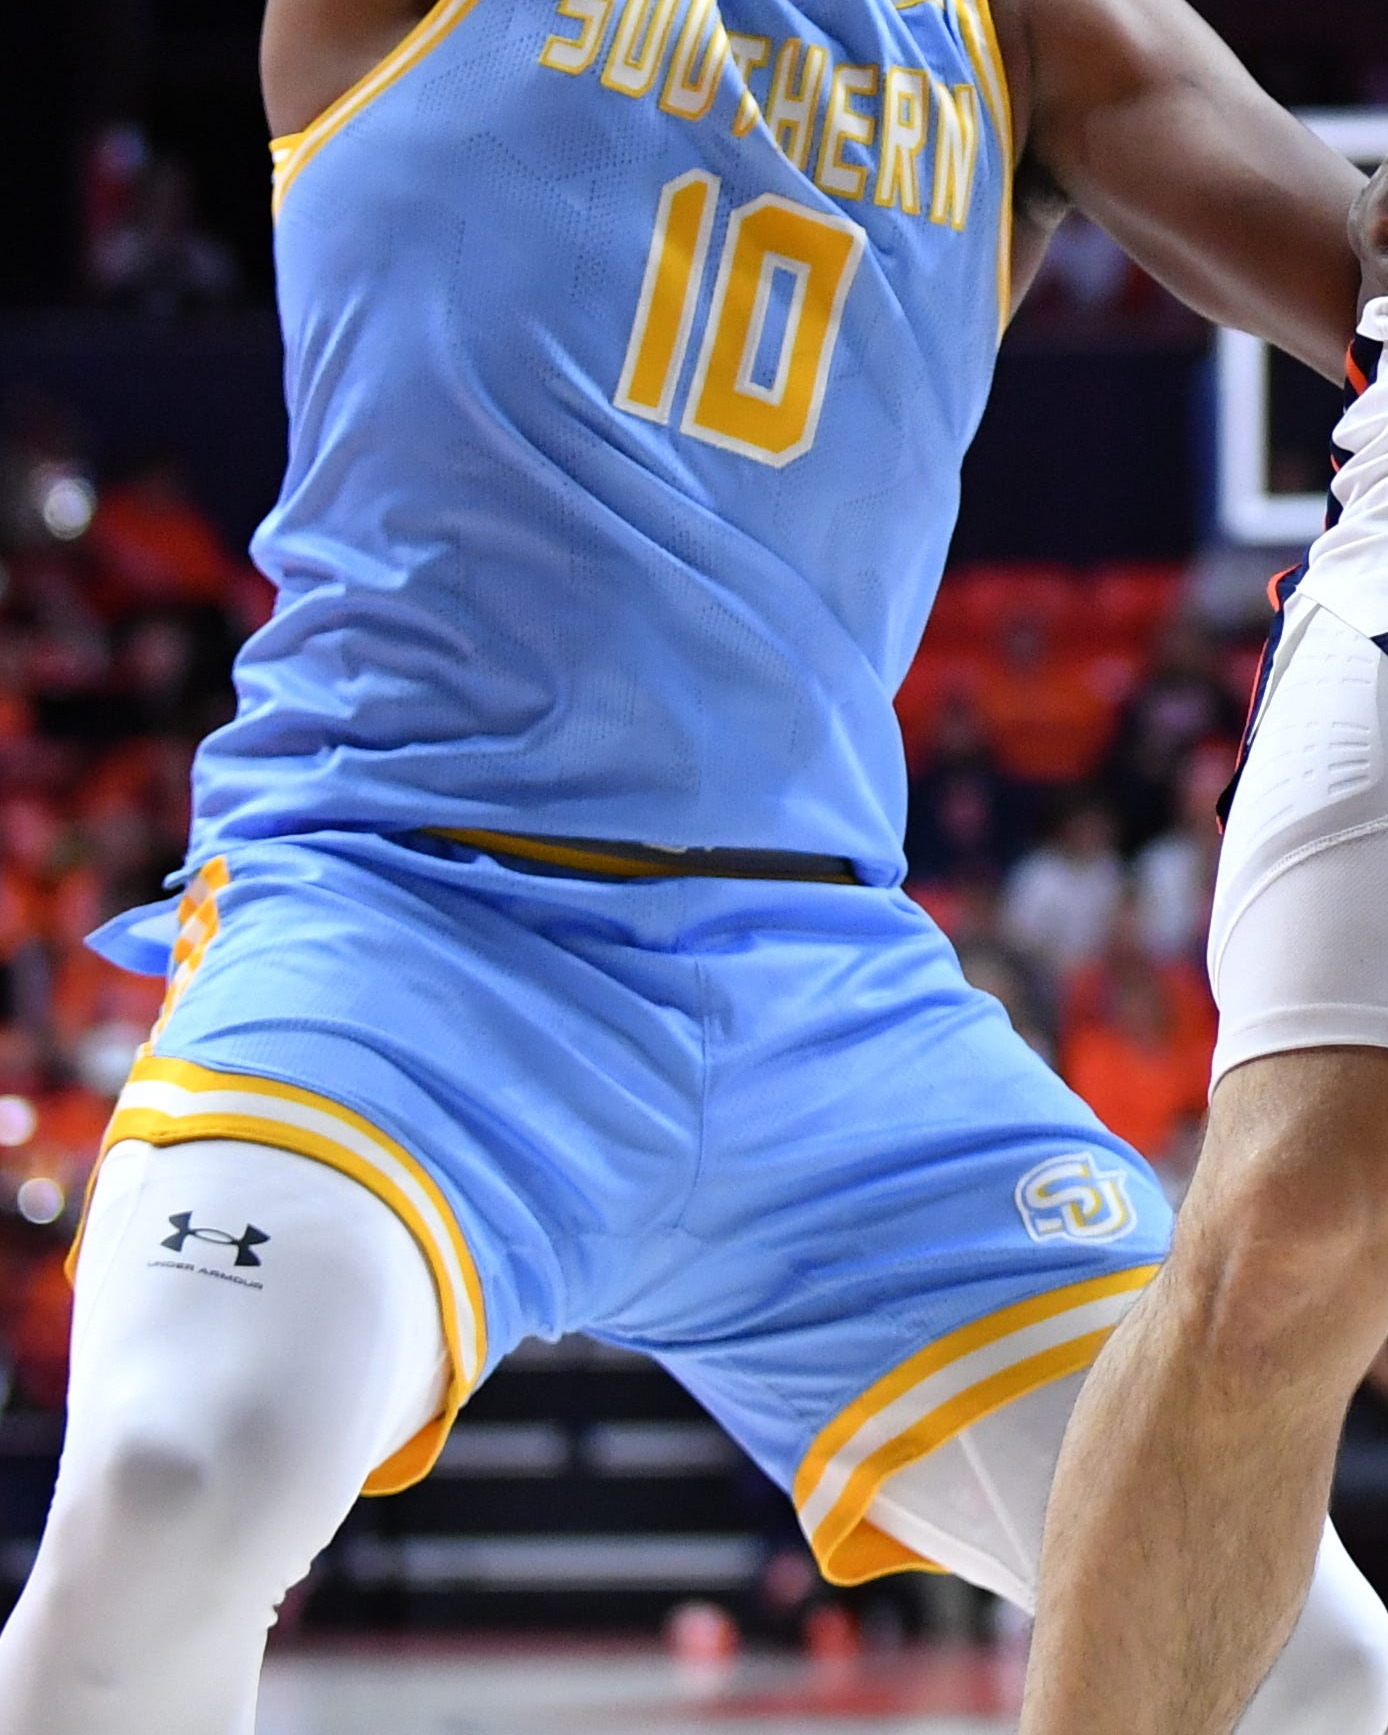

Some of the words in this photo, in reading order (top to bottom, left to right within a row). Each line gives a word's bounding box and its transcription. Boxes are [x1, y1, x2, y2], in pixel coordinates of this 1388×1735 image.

[612, 168, 867, 469] 10
[147, 1260, 195, 1271] UNDER
[198, 1267, 264, 1290] ARMOUR
